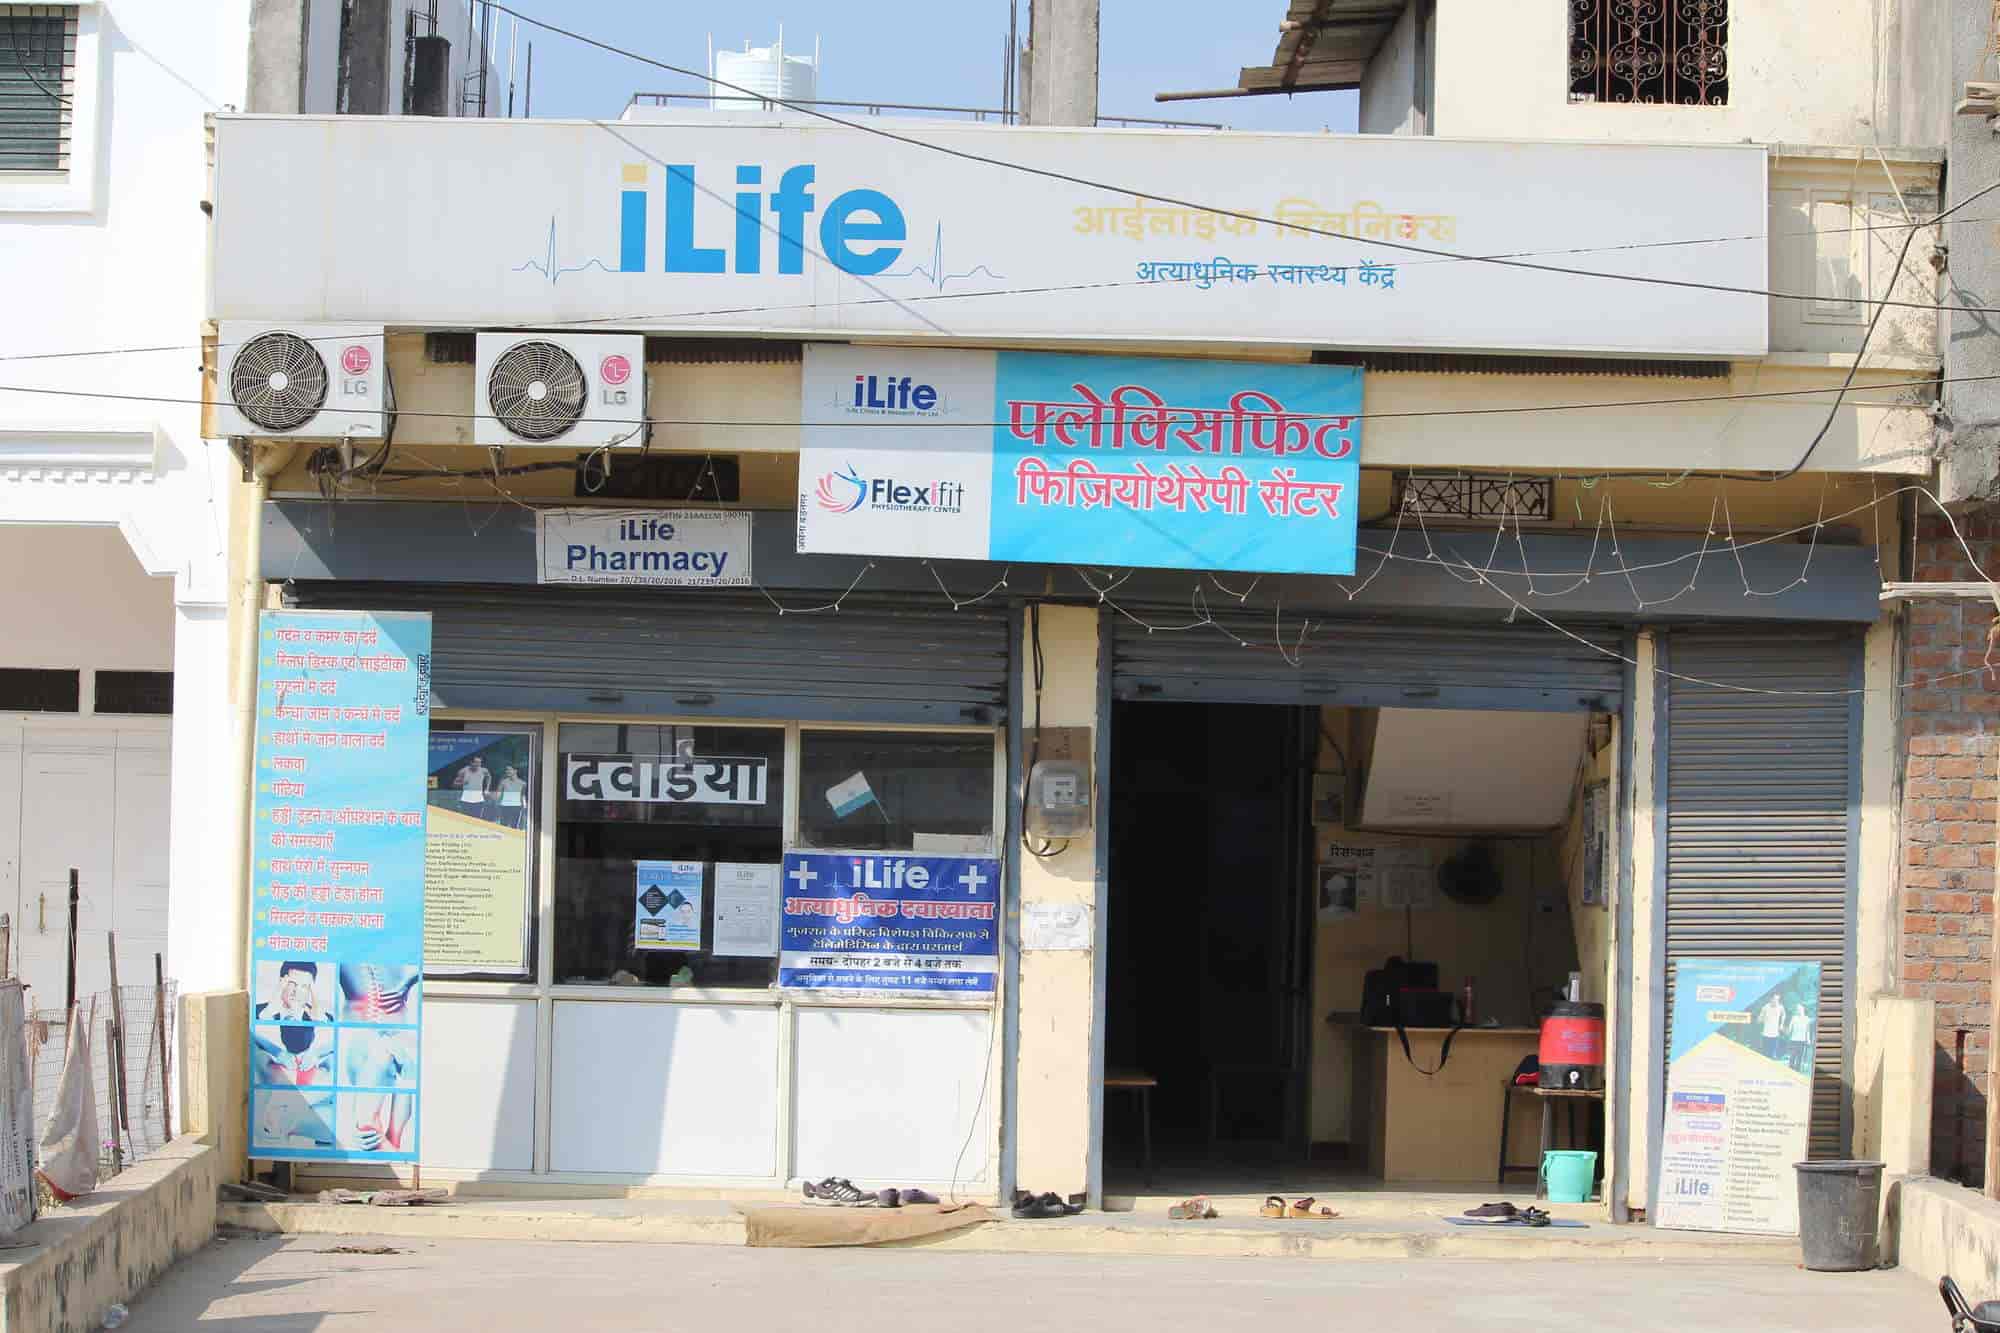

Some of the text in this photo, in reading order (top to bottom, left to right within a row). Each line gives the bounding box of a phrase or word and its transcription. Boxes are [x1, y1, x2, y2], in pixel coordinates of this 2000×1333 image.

[620, 164, 906, 276] iLife
[1136, 256, 1398, 289] अत्याधुनिक स्वास्थ्य केंद्र
[343, 379, 368, 395] LG
[602, 389, 628, 405] LG
[855, 375, 937, 410] iLife
[1007, 384, 1357, 459] फ्लेक्सिफिट
[871, 479, 964, 507] Flexifit
[1016, 457, 1343, 518] फिज़ियोथेरेपी सेंटर
[871, 504, 932, 512] PHYSIOTHERAPY
[620, 519, 675, 541] iLife
[567, 544, 728, 577] Pharmacy
[853, 859, 930, 889] iLife
[784, 892, 995, 923] अत्याधुनिक दवाखाना
[873, 957, 881, 967] 2
[914, 958, 922, 968] 4
[901, 976, 911, 984] 11
[1674, 1176, 1711, 1195] iLife
